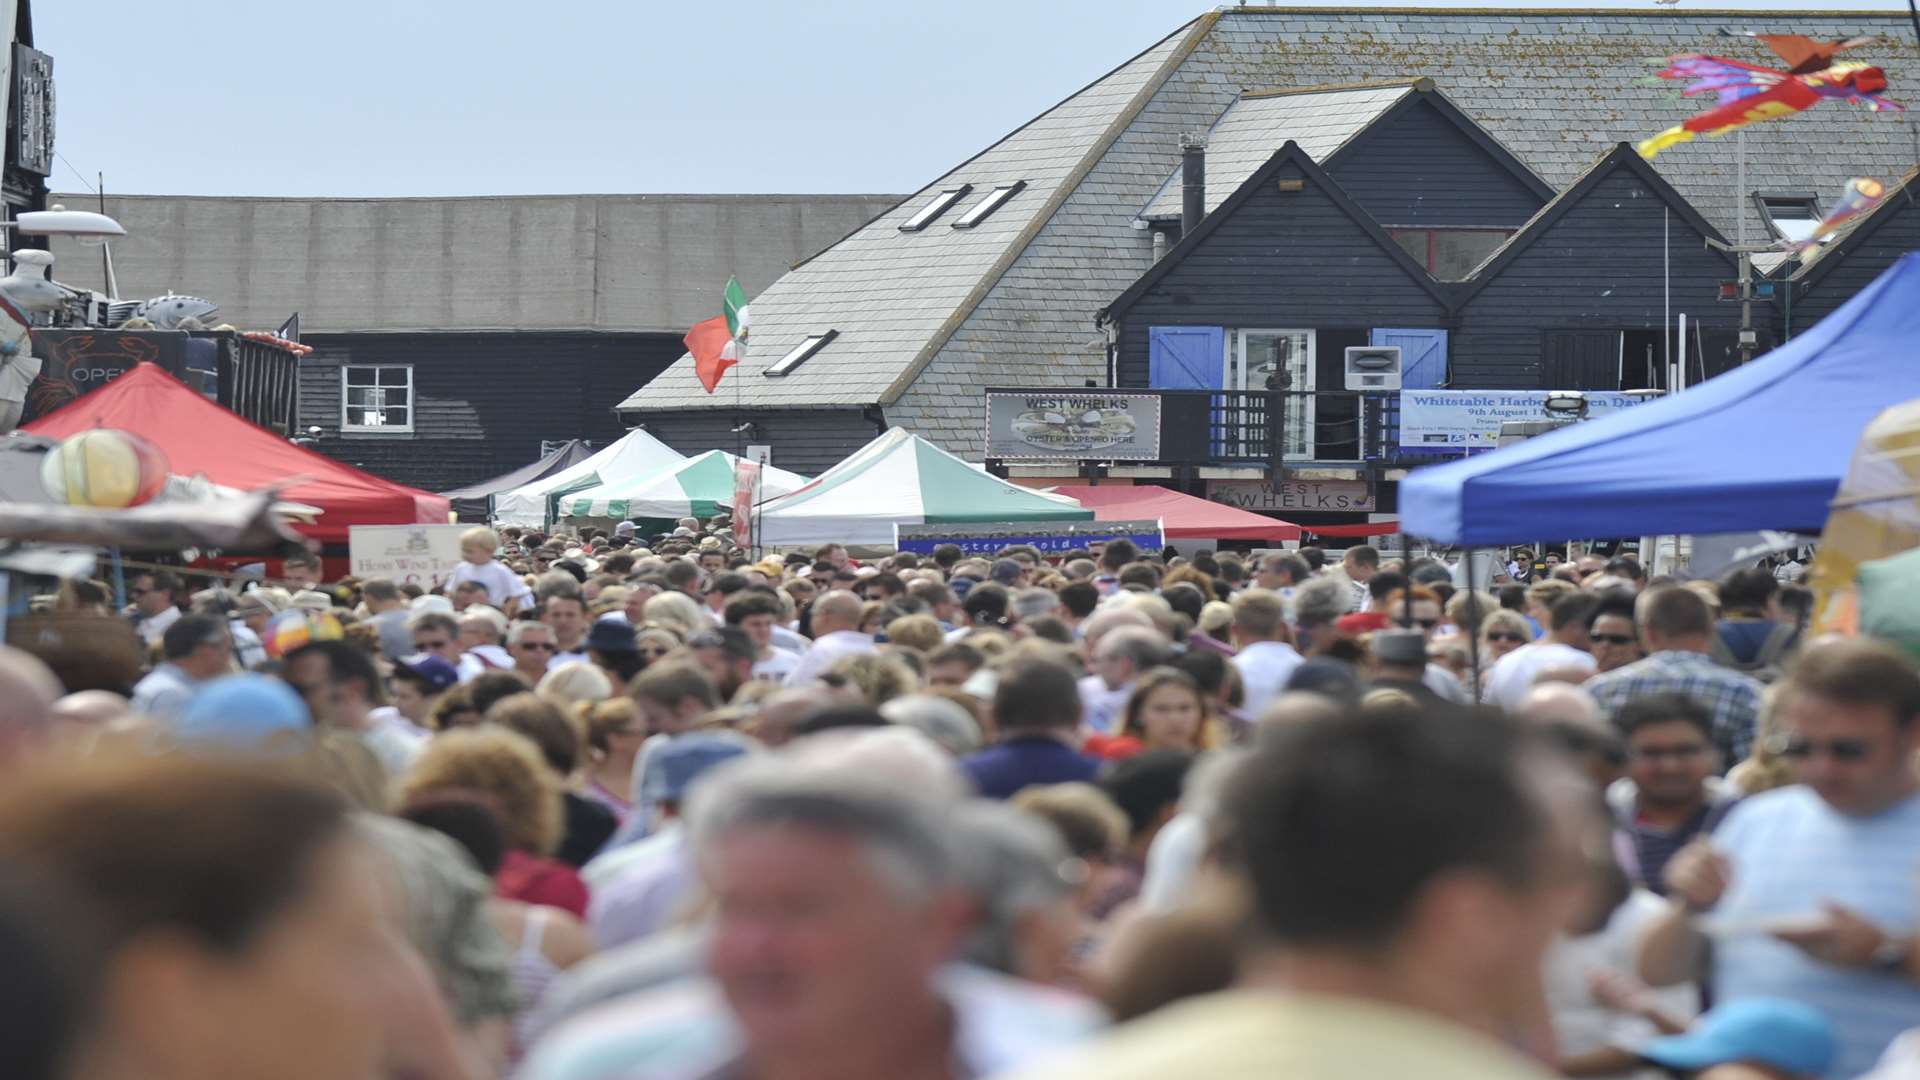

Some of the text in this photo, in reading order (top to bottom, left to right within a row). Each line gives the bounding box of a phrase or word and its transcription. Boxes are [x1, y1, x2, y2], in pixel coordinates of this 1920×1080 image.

[72, 367, 126, 382] OPE
[1025, 398, 1129, 410] WEST WHELKS
[1413, 396, 1496, 407] Whitstable
[1499, 396, 1547, 408] Harbo
[1590, 399, 1608, 407] en
[1467, 407, 1487, 416] 9th
[1488, 407, 1529, 418] August
[1111, 436, 1136, 444] HERE
[1261, 483, 1323, 496] WEST
[1237, 494, 1350, 508] WHELKS
